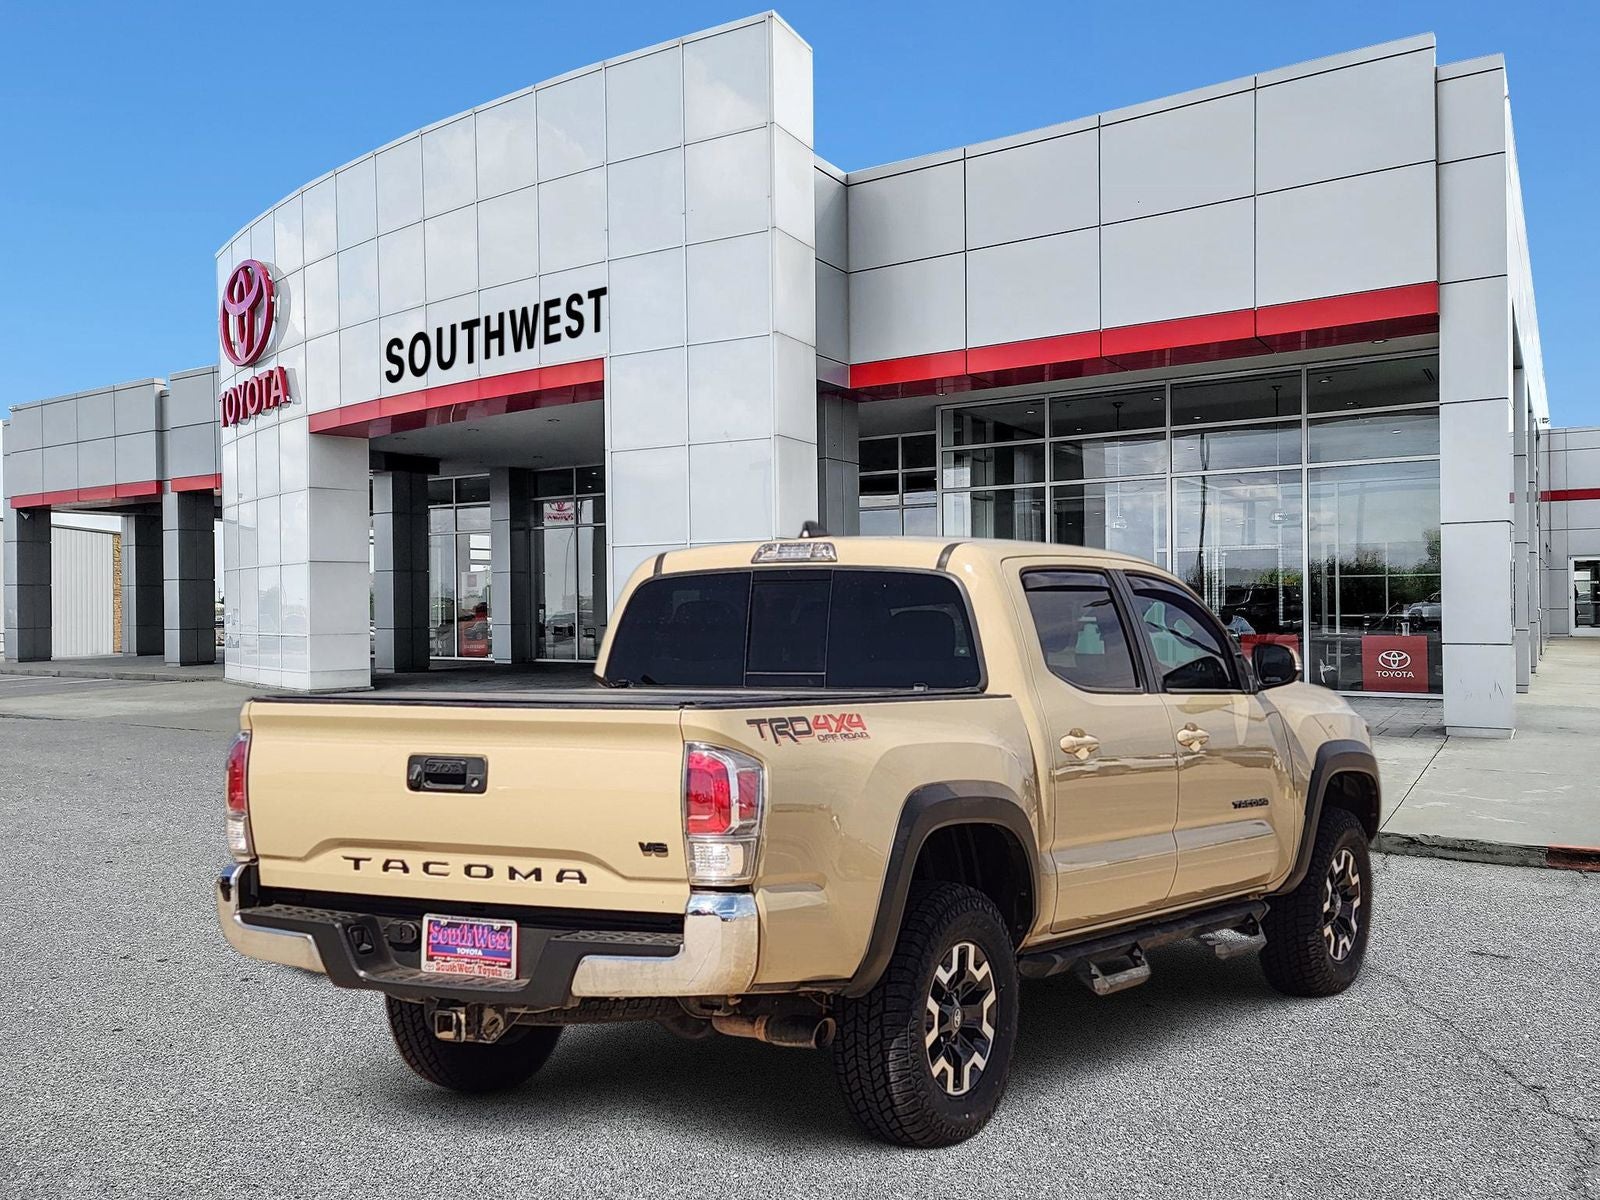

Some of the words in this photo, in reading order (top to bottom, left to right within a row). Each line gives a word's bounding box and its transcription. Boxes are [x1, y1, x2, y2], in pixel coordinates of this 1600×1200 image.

[385, 286, 607, 383] SOUTHWEST
[219, 366, 291, 427] TOYOTA
[1376, 670, 1414, 679] TOYOTA
[746, 716, 814, 745] TRD
[817, 733, 840, 742] OFF
[841, 731, 869, 741] ROAD
[638, 841, 668, 857] V6
[342, 855, 588, 884] TACOMA
[478, 966, 503, 977] Toyota
